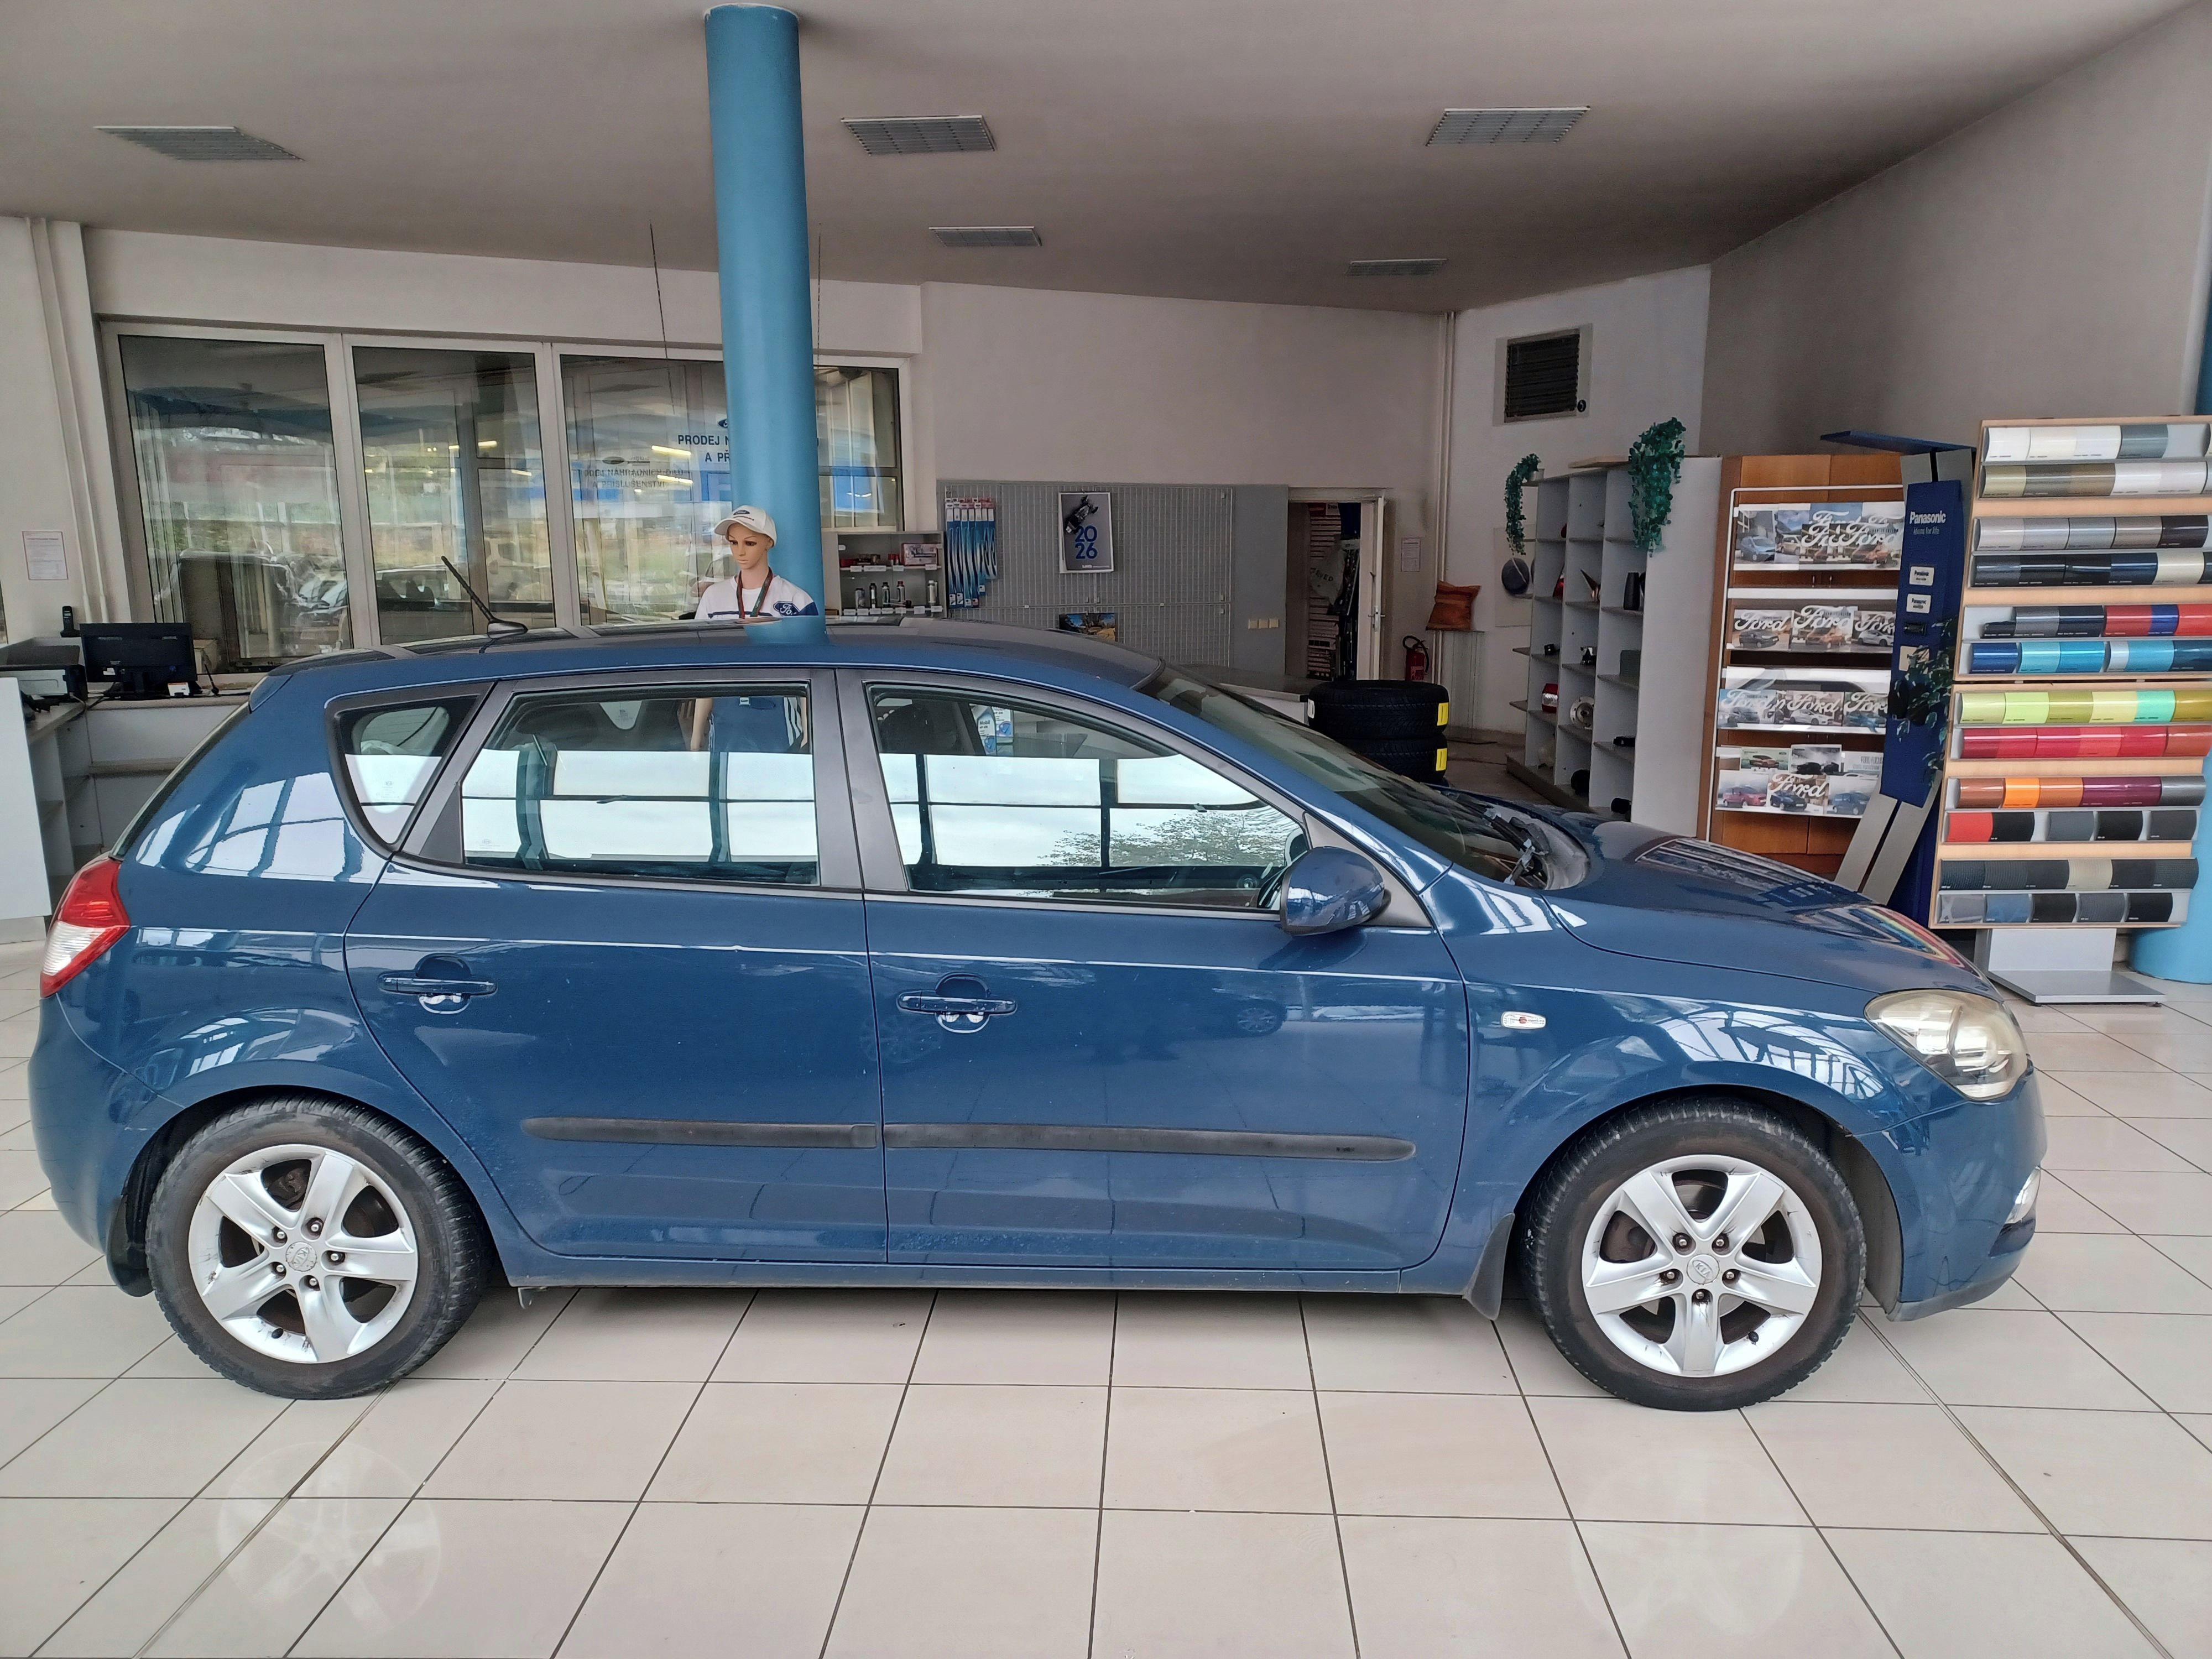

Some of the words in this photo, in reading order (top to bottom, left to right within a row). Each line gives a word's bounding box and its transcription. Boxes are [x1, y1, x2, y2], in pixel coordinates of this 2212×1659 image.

[678, 435, 720, 445] PRODEJ
[705, 452, 712, 462] A
[1910, 510, 1946, 524] Panasonic
[1075, 525, 1098, 542] 20
[1075, 542, 1098, 559] 26
[1734, 611, 1791, 631] Ford
[1793, 605, 1853, 629] Ford
[1787, 691, 1838, 712] Ford
[1767, 774, 1826, 798] Ford
